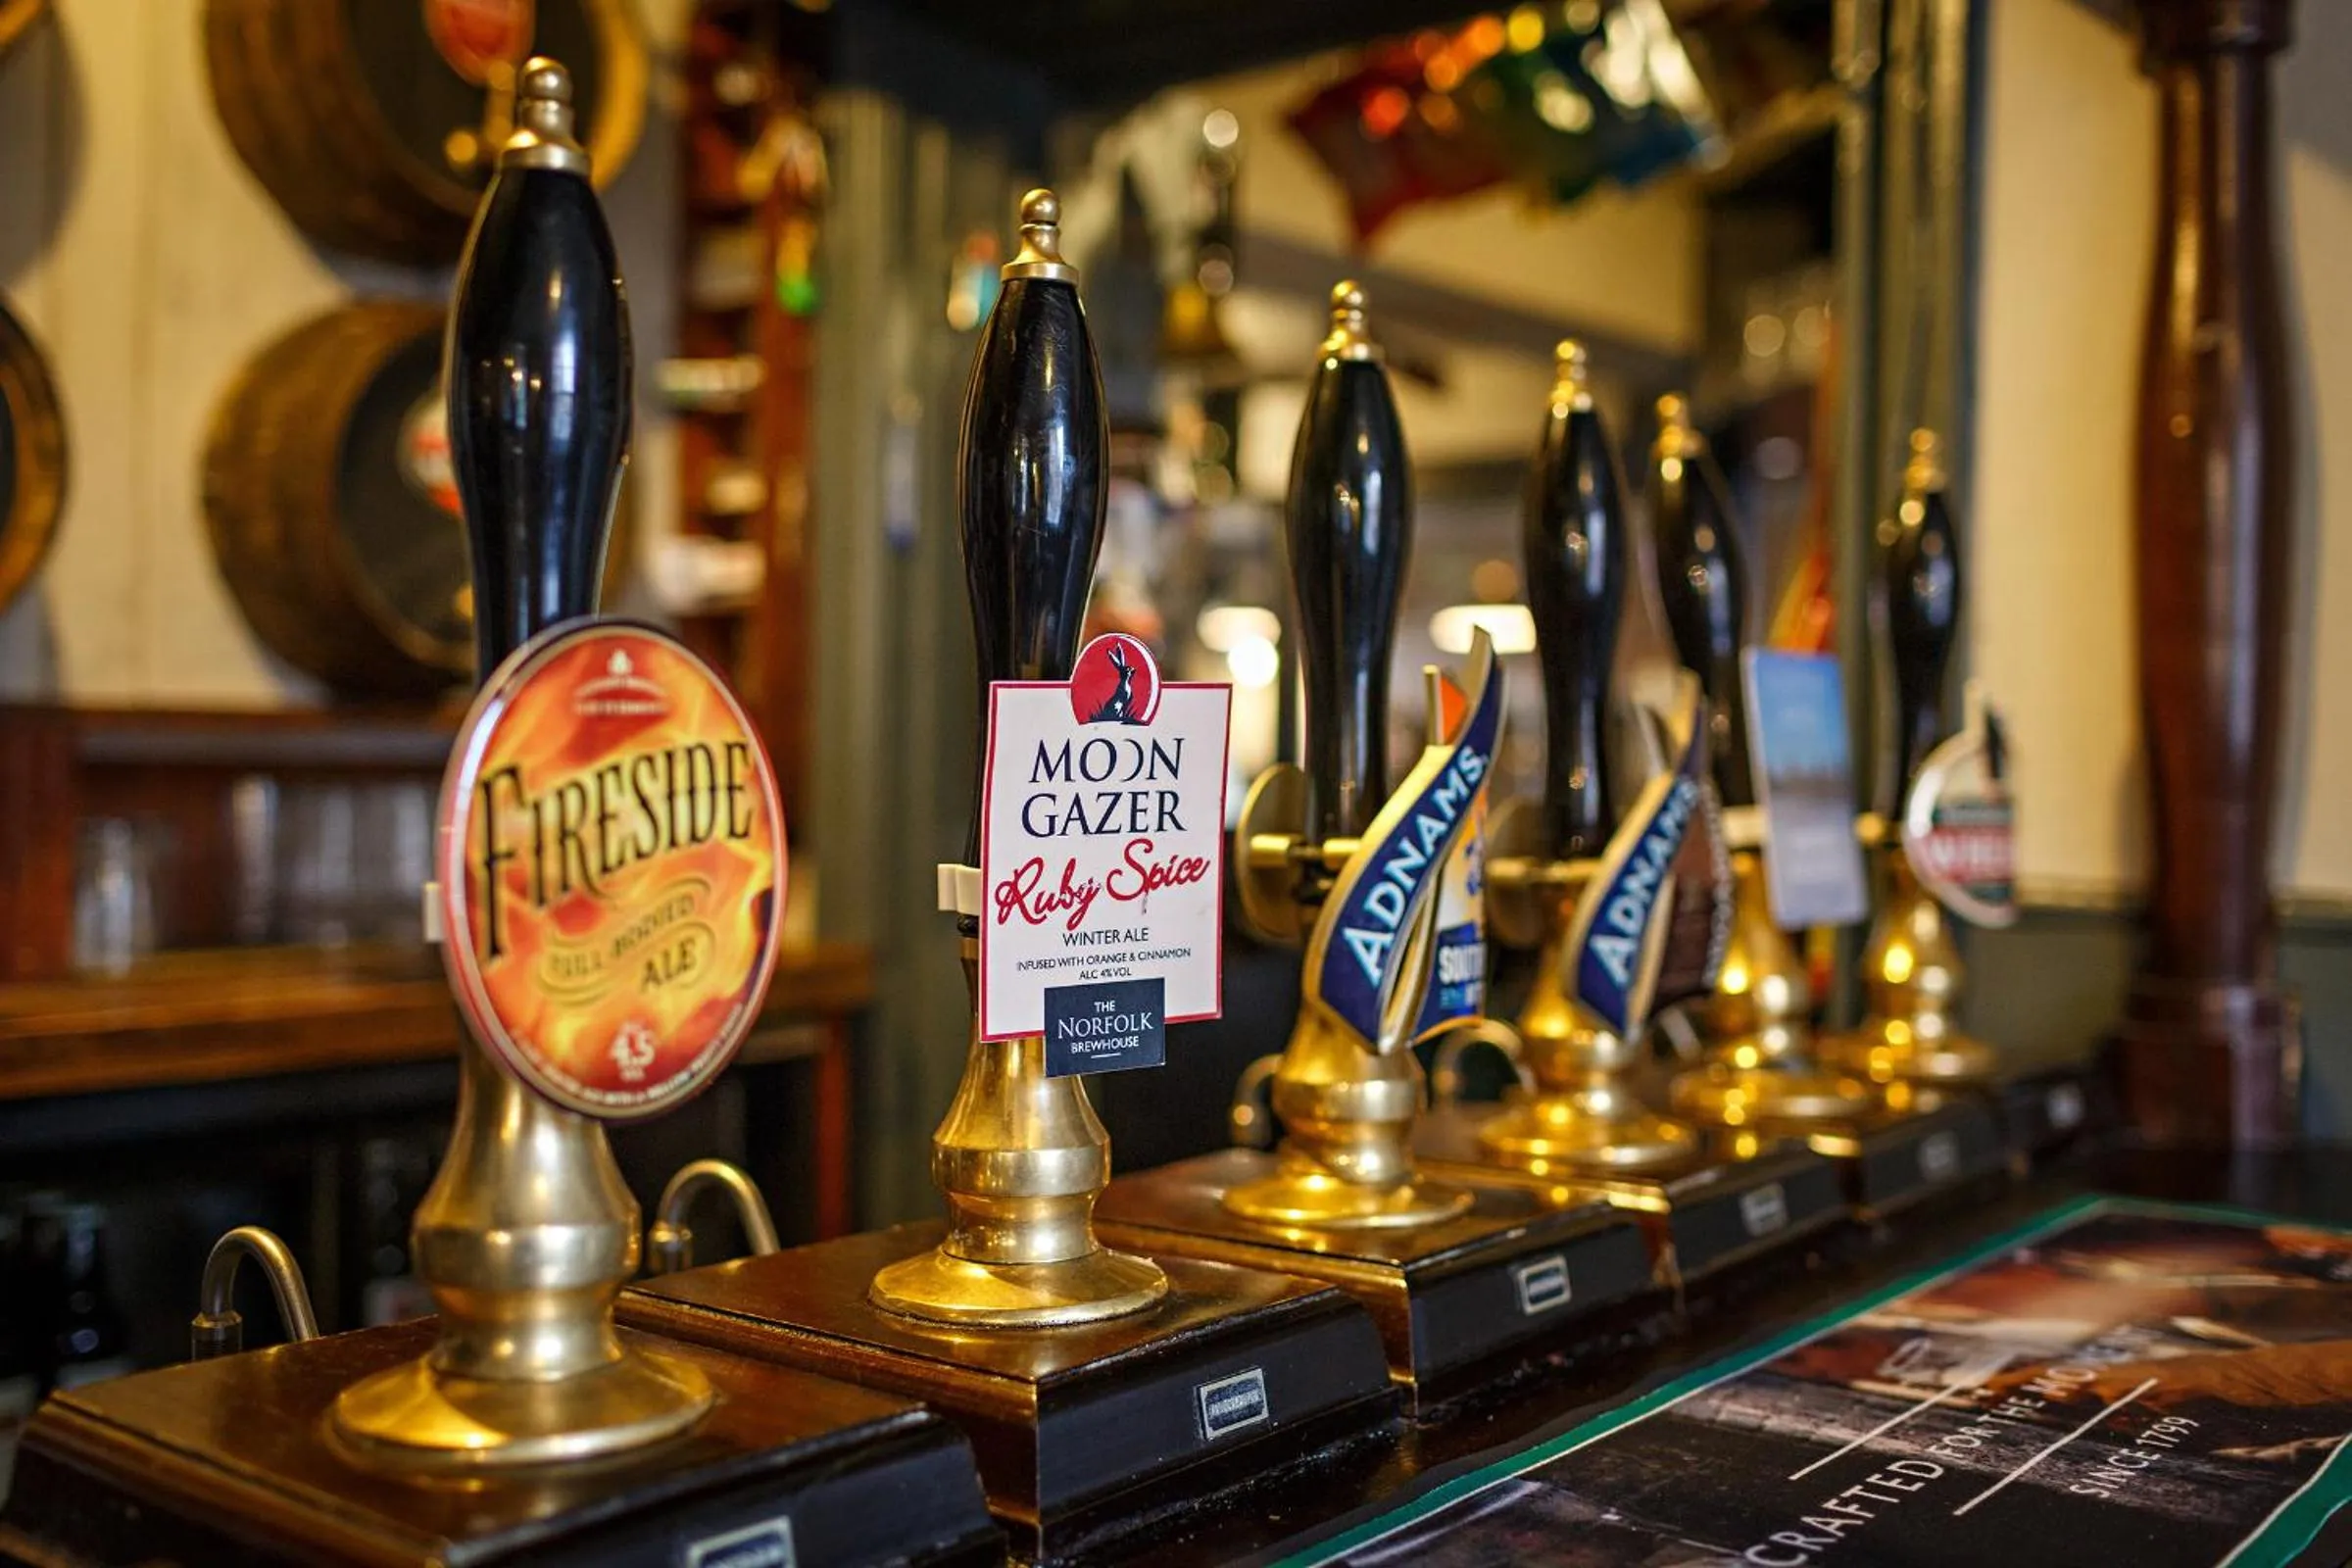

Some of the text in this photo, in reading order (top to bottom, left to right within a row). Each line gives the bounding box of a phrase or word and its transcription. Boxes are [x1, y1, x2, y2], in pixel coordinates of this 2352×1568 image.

[1021, 789, 1187, 839] GAZER
[481, 741, 754, 958] FIRESIDE
[1342, 745, 1487, 986] ADNAMS
[995, 838, 1210, 931] Ruby Spice
[1017, 949, 1191, 971] INFUSED WITH ORANGE & CINNAMON
[1062, 927, 1150, 947] WINTER ALE
[641, 937, 698, 994] ALE
[1079, 969, 1099, 981] ALC
[1058, 1012, 1153, 1039] NORFOLK
[1094, 1001, 1116, 1013] THE
[1070, 1036, 1140, 1054] BREWHOUSE
[1744, 1458, 1944, 1567] CRAFTED
[1925, 1425, 2001, 1458] FOR
[1977, 1396, 2046, 1425] THE
[2069, 1416, 2200, 1498] SINCE 1799
